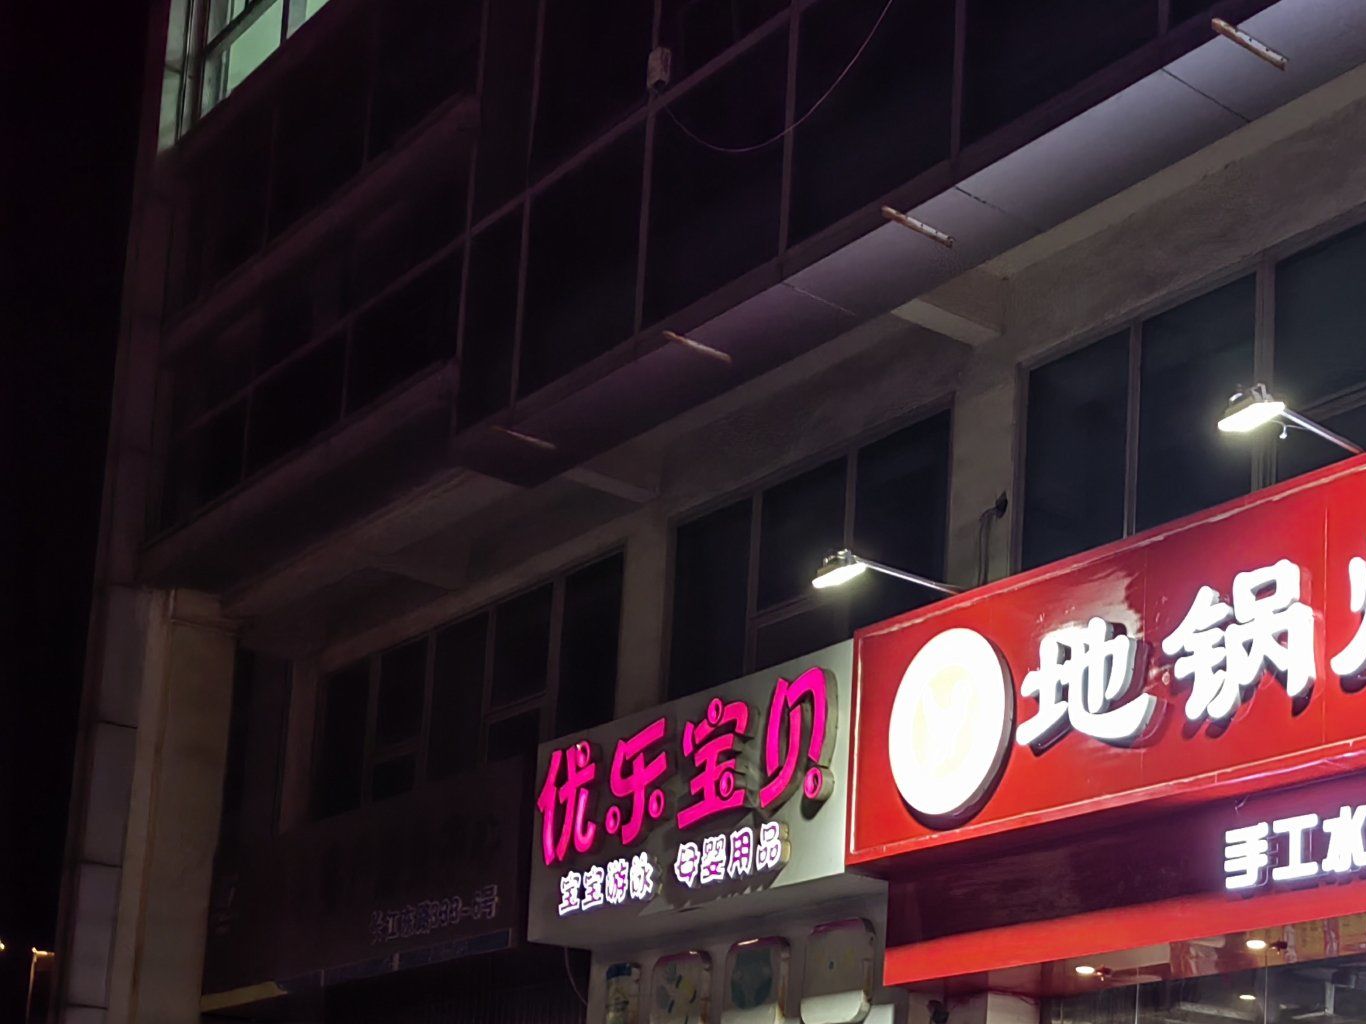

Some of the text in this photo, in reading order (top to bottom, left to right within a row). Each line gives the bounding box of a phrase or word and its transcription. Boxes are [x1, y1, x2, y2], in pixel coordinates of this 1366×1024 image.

[537, 667, 826, 866] 优乐宝贝
[558, 820, 781, 916] 宝宝游泳 母婴用品
